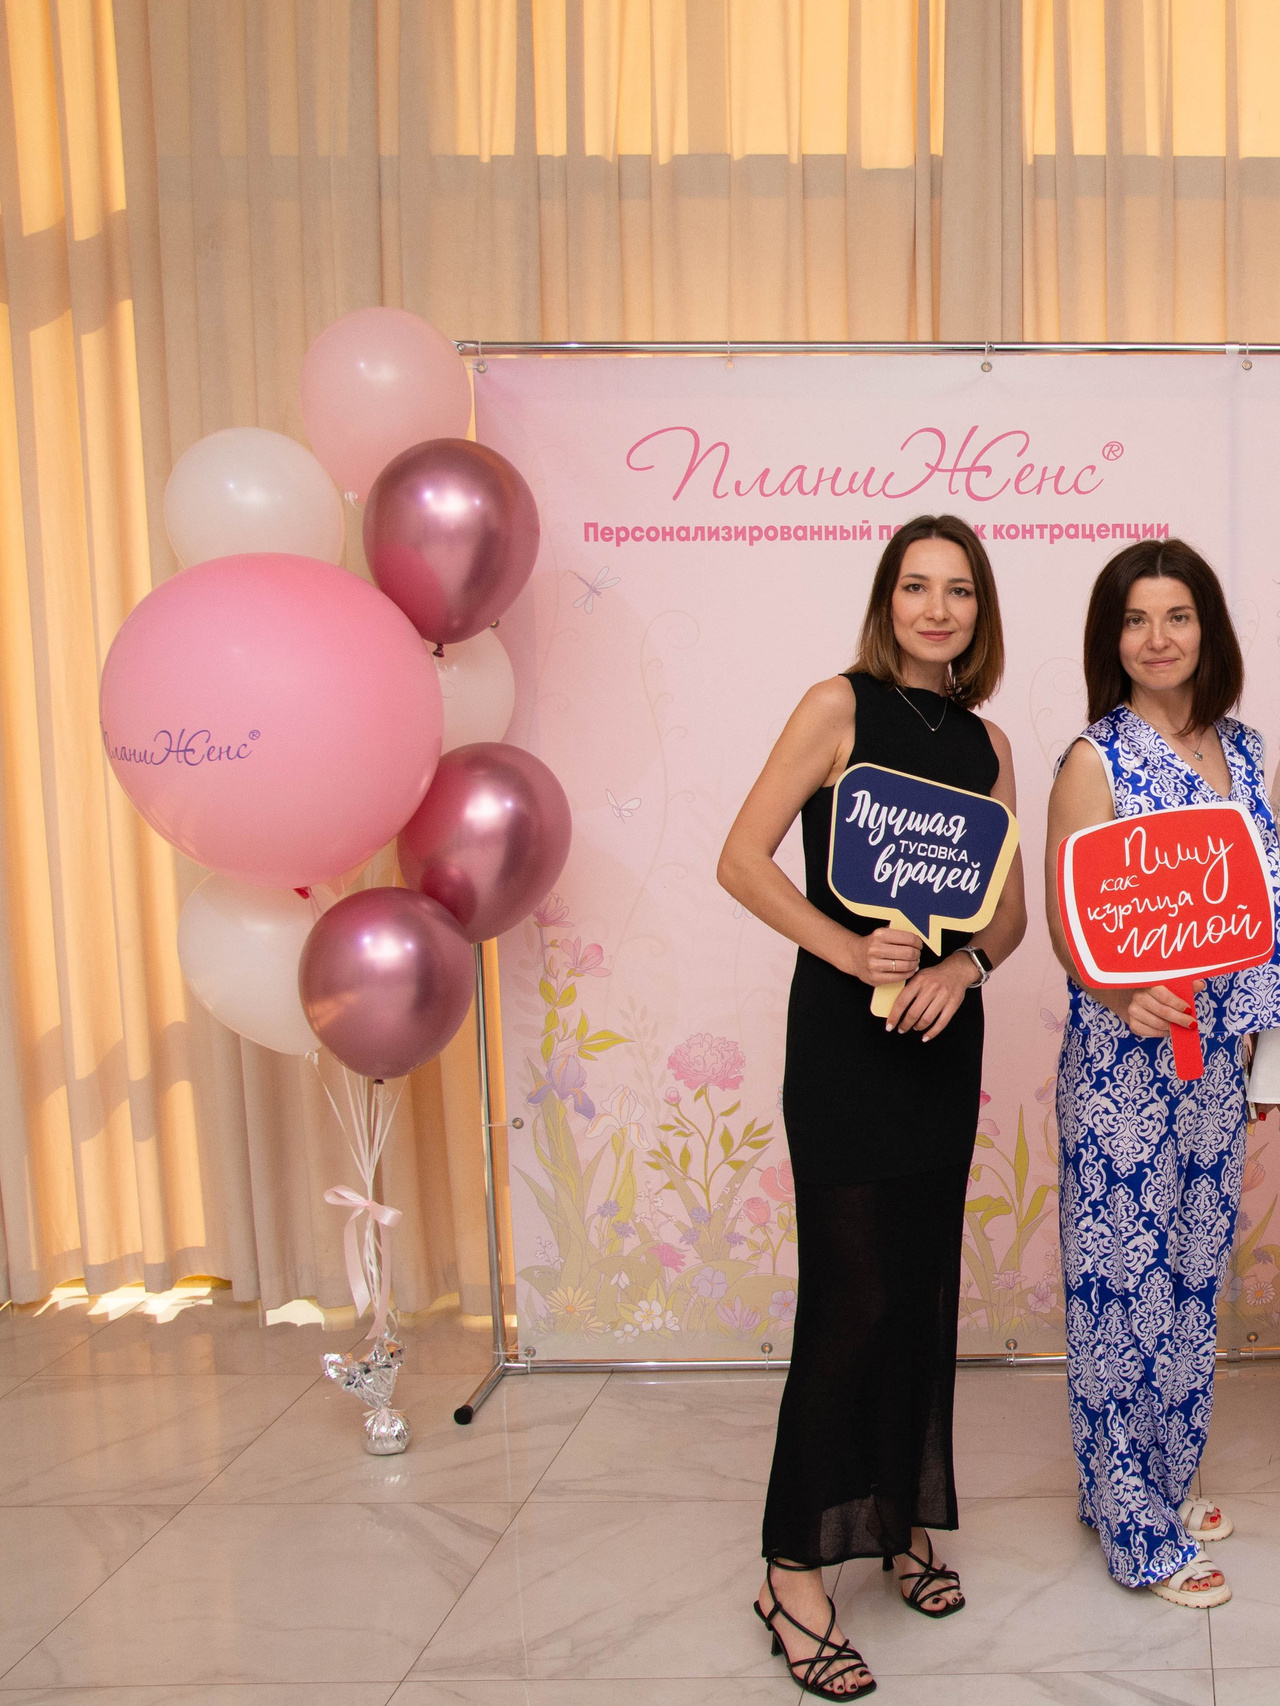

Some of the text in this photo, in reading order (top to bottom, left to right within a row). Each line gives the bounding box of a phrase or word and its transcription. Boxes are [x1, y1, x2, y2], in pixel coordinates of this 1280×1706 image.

[583, 520, 872, 547] Персонализированный
[992, 522, 1170, 545] контрацепции
[845, 789, 967, 846] Лучшая
[873, 843, 981, 899] врачей
[899, 839, 969, 863] ТУСОВКА
[1124, 826, 1234, 905] Пишу
[1100, 874, 1140, 894] как
[1087, 890, 1194, 933] курица
[1117, 904, 1262, 959] лапой
